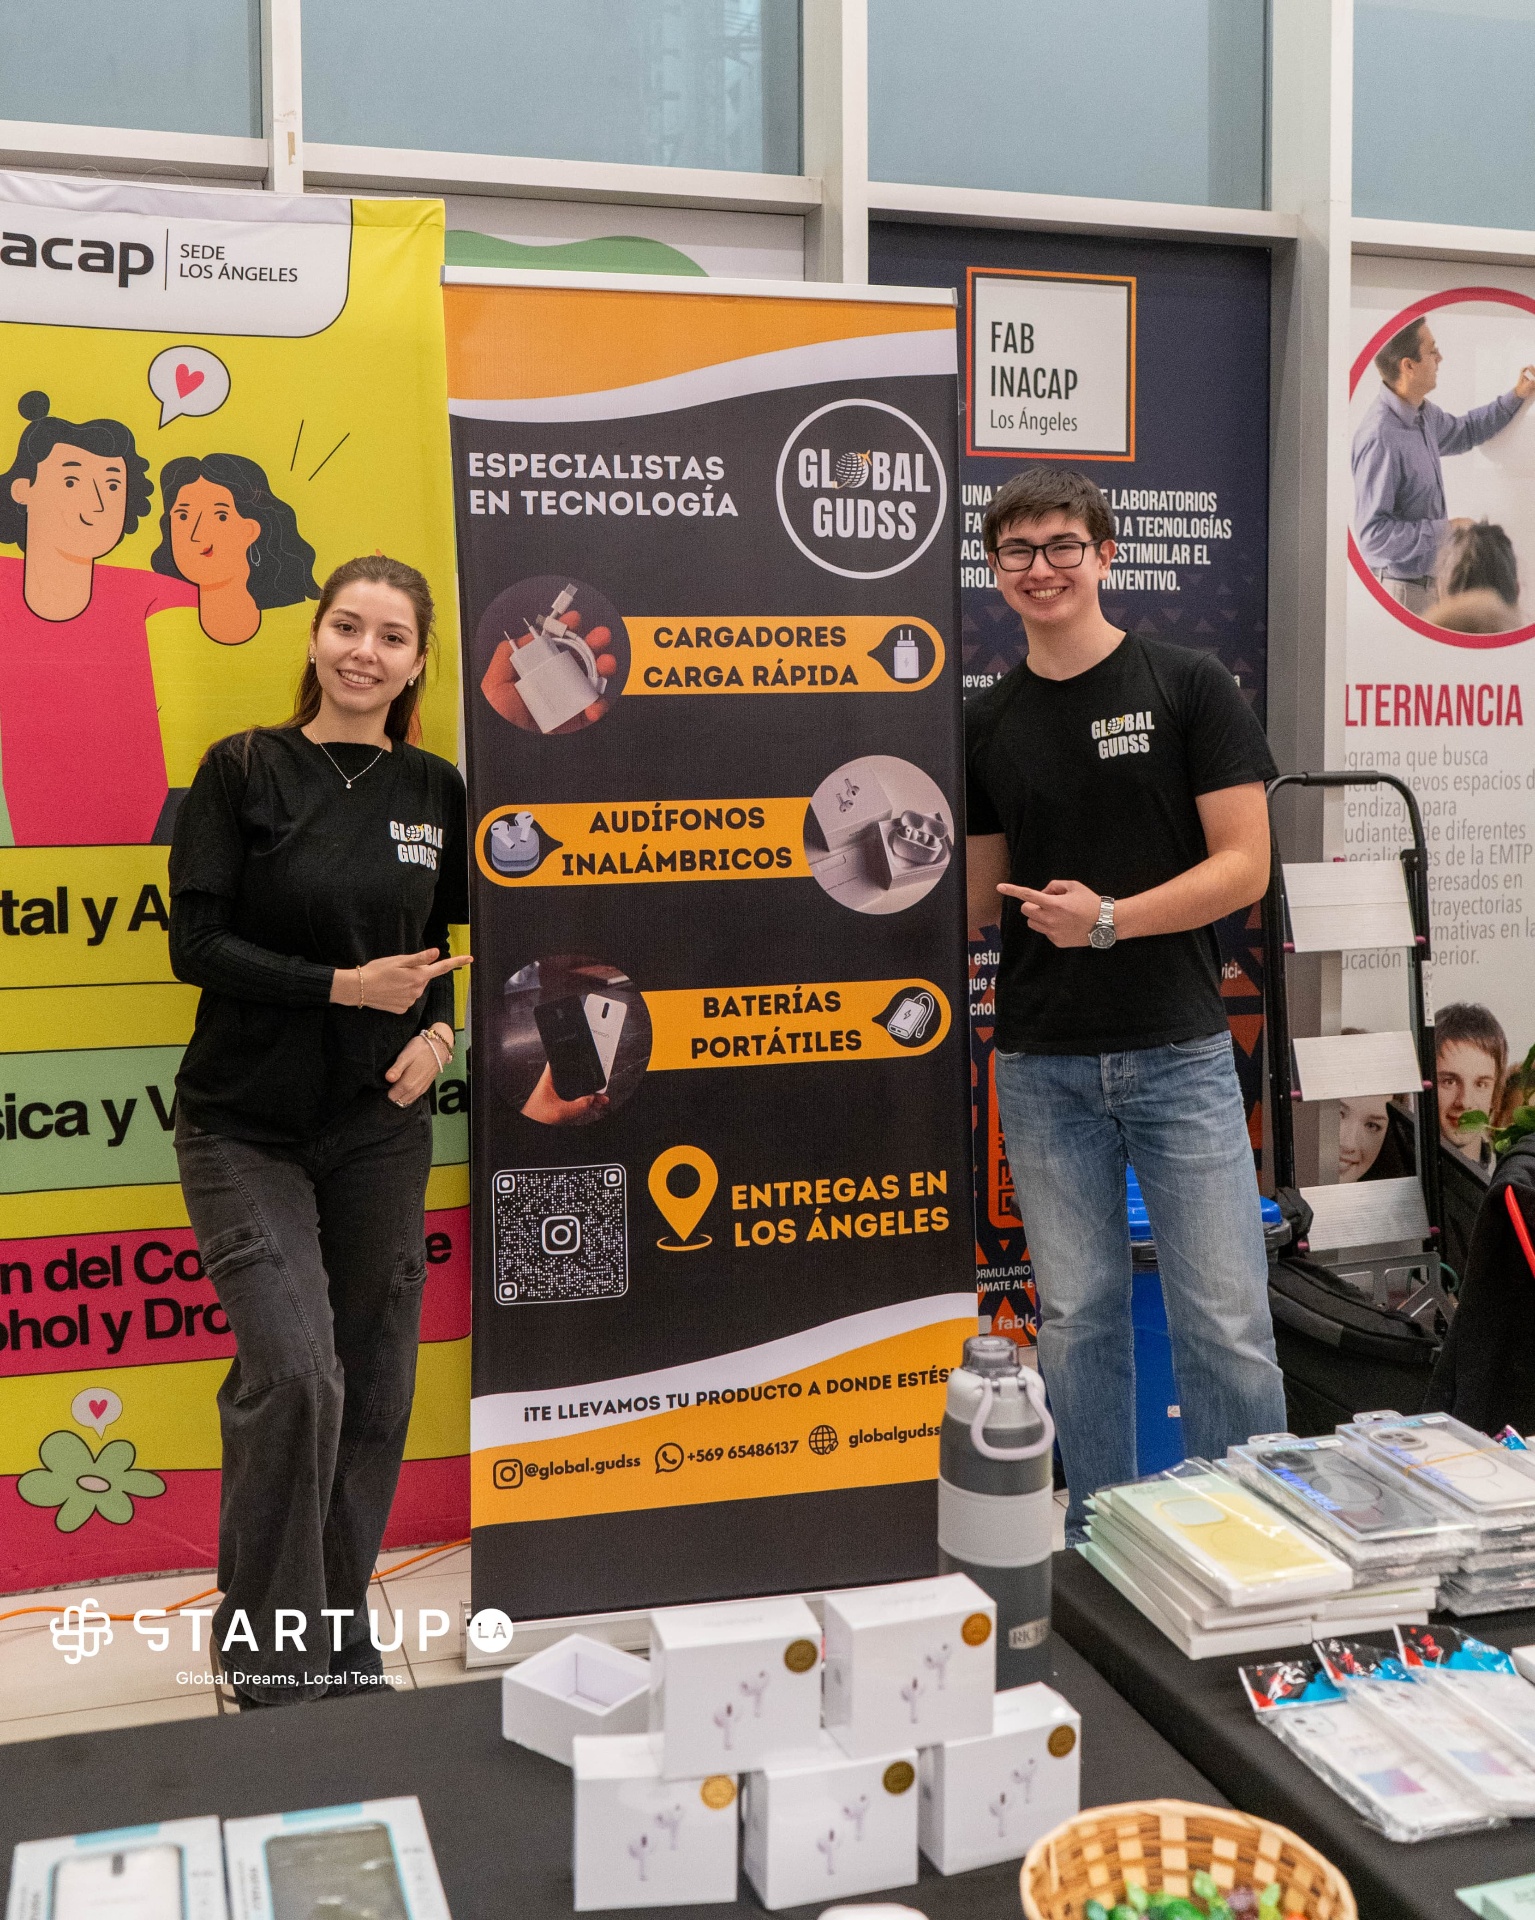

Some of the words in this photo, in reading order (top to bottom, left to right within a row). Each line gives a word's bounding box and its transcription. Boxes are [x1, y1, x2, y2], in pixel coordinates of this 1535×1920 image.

[0, 231, 155, 288] acap
[180, 243, 226, 261] SEDE
[179, 264, 213, 280] LOS
[218, 262, 299, 284] ÁNGELES
[991, 321, 1035, 354] FAB
[990, 365, 1078, 400] INACAP
[990, 409, 1014, 430] Los
[1018, 407, 1078, 435] Ángeles
[468, 452, 724, 481] ESPECIALISTAS
[798, 447, 931, 493] GLOBAL
[470, 489, 510, 516] EN
[521, 484, 739, 517] TECNOLOGÍA
[962, 485, 992, 506] UNA
[1111, 489, 1217, 512] LABORATORIOS
[813, 497, 917, 541] GUDSS
[965, 512, 986, 533] FA
[1123, 516, 1133, 537] A
[1136, 514, 1232, 539] TECNOLOGÍAS
[1194, 544, 1211, 565] EL
[653, 626, 846, 649] CARGADORES
[643, 665, 744, 688] CARGA
[752, 659, 859, 687] RÁPIDA
[1091, 711, 1155, 740] GLOBAL
[1098, 733, 1150, 759] GUDSS
[1344, 749, 1400, 772] grama
[1406, 749, 1438, 773] que
[1443, 744, 1488, 766] busca
[1453, 771, 1521, 797] espacios
[589, 802, 765, 834] AUDÍFONOS
[1423, 800, 1457, 822] para
[389, 820, 443, 849] GLOBAL
[1446, 818, 1526, 841] diferentes
[397, 843, 437, 871] GUDSS
[561, 843, 793, 876] INALÁMBRICOS
[1446, 848, 1465, 867] de
[1471, 844, 1484, 866] la
[1489, 843, 1533, 865] EMTP
[1503, 874, 1523, 890] en
[81, 896, 119, 946] y
[1432, 894, 1523, 922] trayectorias
[1501, 923, 1520, 939] en
[703, 985, 841, 1019] BATERÍAS
[690, 1029, 862, 1059] PORTÁTILES
[0, 1092, 90, 1141] ica
[101, 1098, 138, 1147] y
[731, 1174, 899, 1210] ENTREGAS
[910, 1170, 948, 1196] EN
[735, 1218, 797, 1247] LOS
[806, 1206, 949, 1242] ÁNGELES
[44, 1248, 122, 1293] del
[1012, 1279, 1026, 1290] AL
[0, 1304, 90, 1351] hol
[100, 1310, 132, 1354] y
[558, 1394, 661, 1421] LLEVAMOS
[665, 1392, 690, 1409] TU
[696, 1381, 802, 1407] PRODUCTO
[808, 1380, 821, 1396] A
[827, 1373, 892, 1396] DONDE
[897, 1364, 954, 1388] ESTÉS
[524, 1453, 641, 1481] @global.gudss
[687, 1446, 724, 1464] +569
[727, 1439, 799, 1459] 65486137
